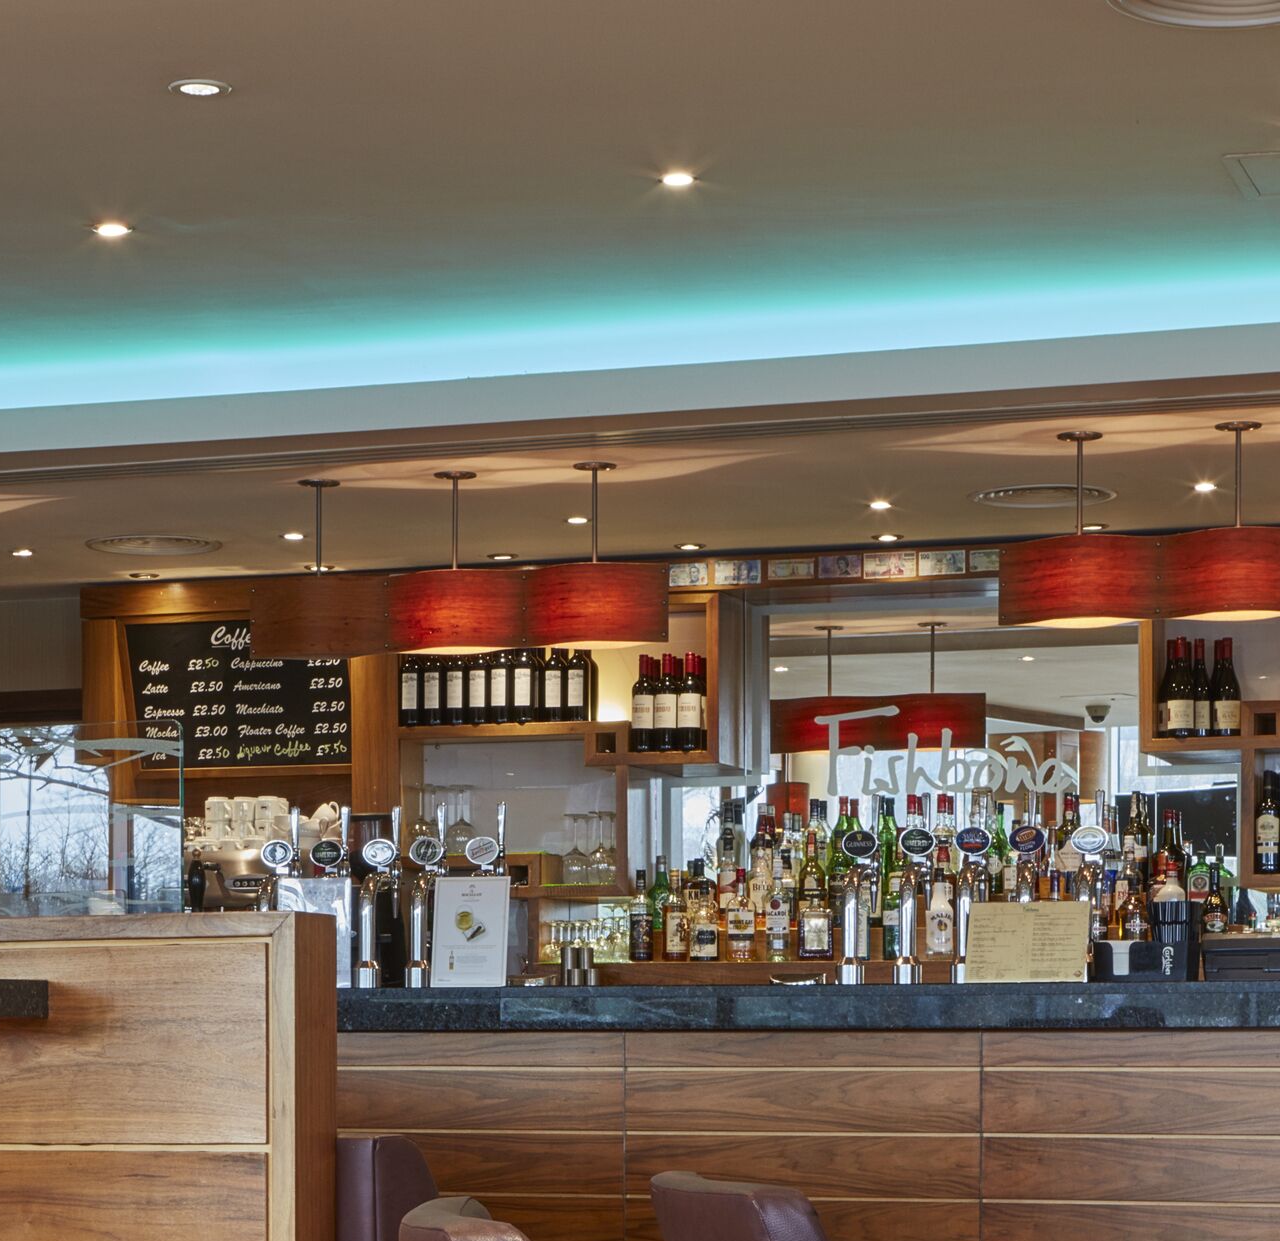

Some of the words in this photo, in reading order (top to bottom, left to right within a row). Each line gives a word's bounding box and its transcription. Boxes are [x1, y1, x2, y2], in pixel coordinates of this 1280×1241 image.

[138, 660, 170, 675] Coffee
[187, 657, 219, 671] £2.50
[230, 657, 284, 672] Cappuccino
[142, 682, 169, 695] Latte
[190, 681, 224, 693] £2.50
[232, 680, 282, 692] Americano
[309, 677, 343, 689] £2.50
[144, 706, 185, 720] Espresso
[192, 704, 226, 717] £2.50
[235, 703, 285, 716] Macchiato
[311, 700, 345, 713] £2.50
[145, 726, 179, 739] Mocha
[194, 726, 228, 738] £3.00
[237, 724, 272, 738] Floater
[275, 723, 306, 738] Coffee
[313, 722, 347, 735] £2.50
[151, 751, 166, 761] Tea
[197, 747, 230, 760] £2.50
[316, 739, 348, 757] £5.50
[814, 705, 1078, 797] Fishbone
